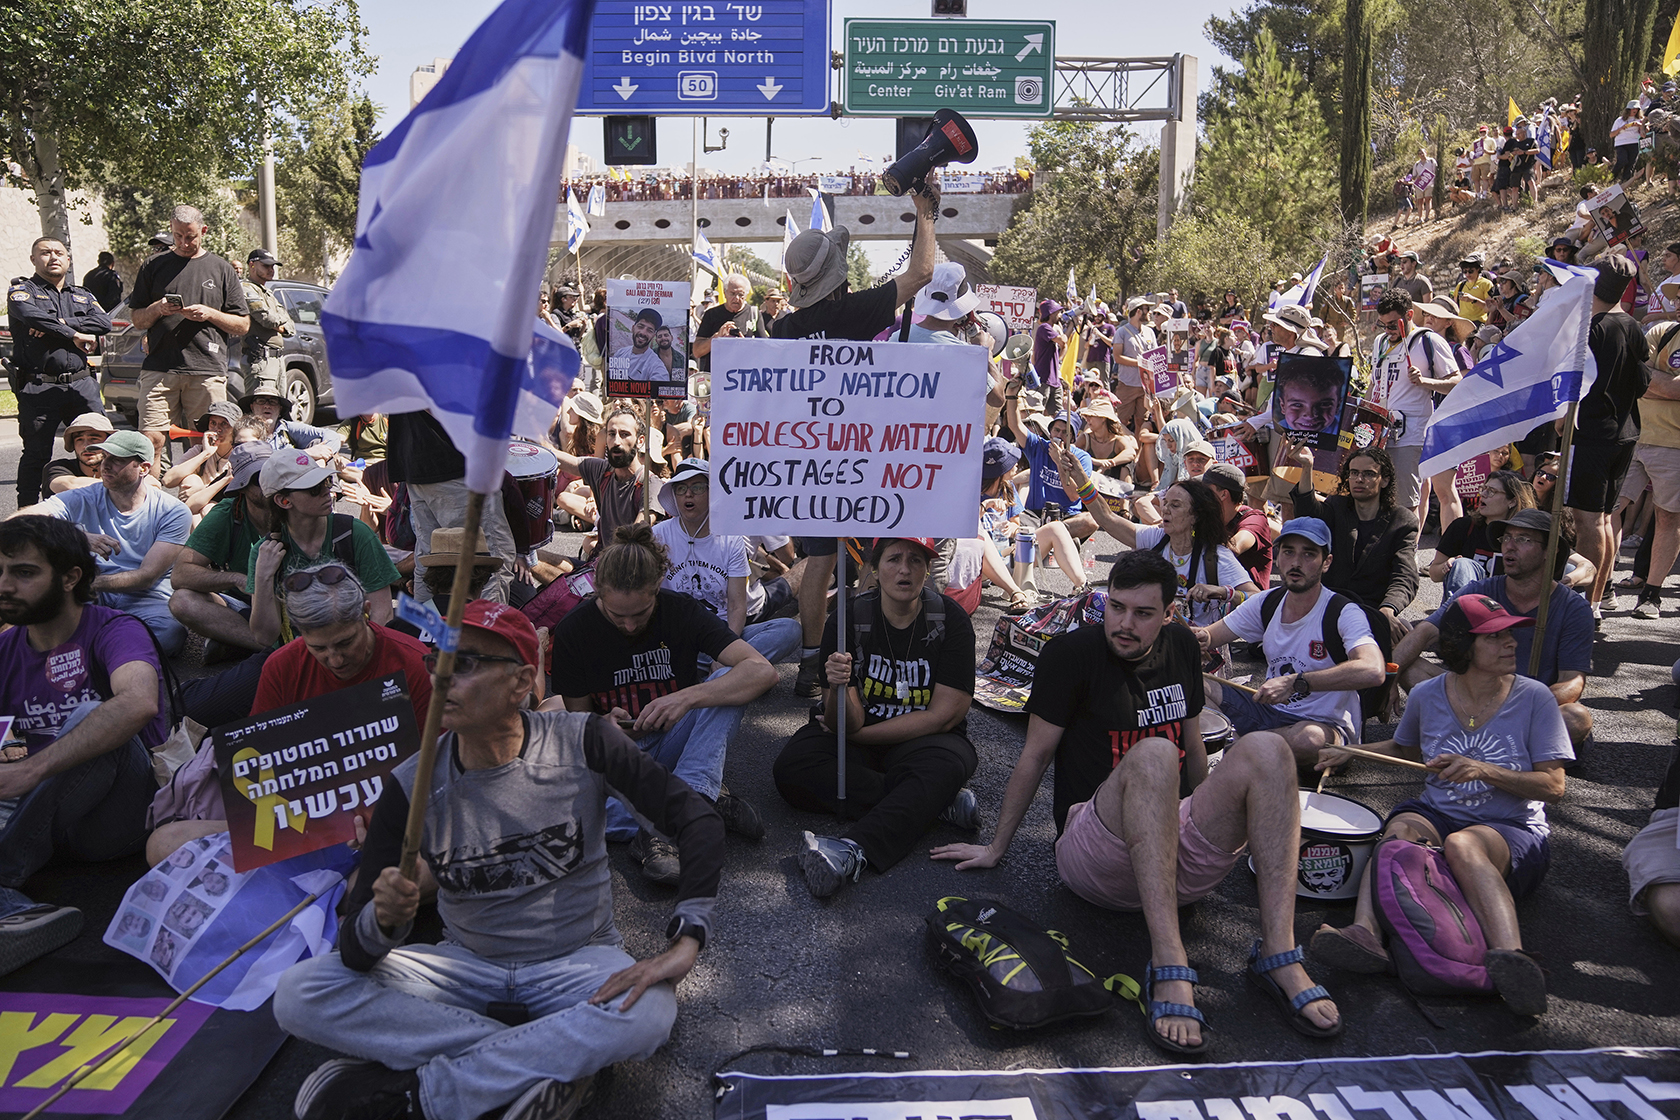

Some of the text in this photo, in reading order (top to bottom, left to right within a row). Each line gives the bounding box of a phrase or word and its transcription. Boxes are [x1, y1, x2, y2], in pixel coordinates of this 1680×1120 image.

[634, 6, 672, 25] צפון
[682, 6, 715, 25] בגין
[634, 28, 672, 45] شمال
[731, 28, 762, 44] جادة
[853, 37, 1004, 55] גבעת רם מרכז העיר
[622, 50, 774, 66] Begin Blvd North
[854, 60, 893, 78] المدينة
[898, 62, 927, 80] مركز
[939, 62, 957, 80] رام
[688, 79, 707, 92] 50
[868, 84, 1006, 98] Center Giv'at Ram
[654, 290, 673, 298] BERMAN
[609, 357, 630, 369] BRING
[809, 345, 875, 366] FROM
[609, 369, 629, 380] THEM
[609, 381, 651, 394] HOME NOW!
[840, 371, 941, 399] NATION
[807, 397, 845, 416] TO
[722, 421, 972, 454] ENDLESS-WAR NATION
[718, 456, 943, 495] (HOSTAGES NOT
[1456, 473, 1485, 485] החטוף
[744, 493, 905, 530] INCLUDED)
[666, 562, 687, 581] BRING
[688, 560, 709, 568] THEM
[50, 649, 81, 666] מסרבים
[51, 658, 81, 674] למלחמה
[632, 648, 671, 669] מחזירים
[614, 664, 675, 686] אותם הביתה
[1146, 683, 1185, 707] מחזירים
[1165, 700, 1187, 720] אותם
[15, 716, 46, 729] ביחד
[256, 722, 267, 731] על
[268, 715, 293, 726] תעמוד
[245, 725, 256, 735] דם
[233, 715, 399, 778] שחרור החטופים
[247, 742, 398, 800] וסיום המלחמה
[274, 775, 384, 830] עכשיו
[1307, 846, 1340, 858] מממן
